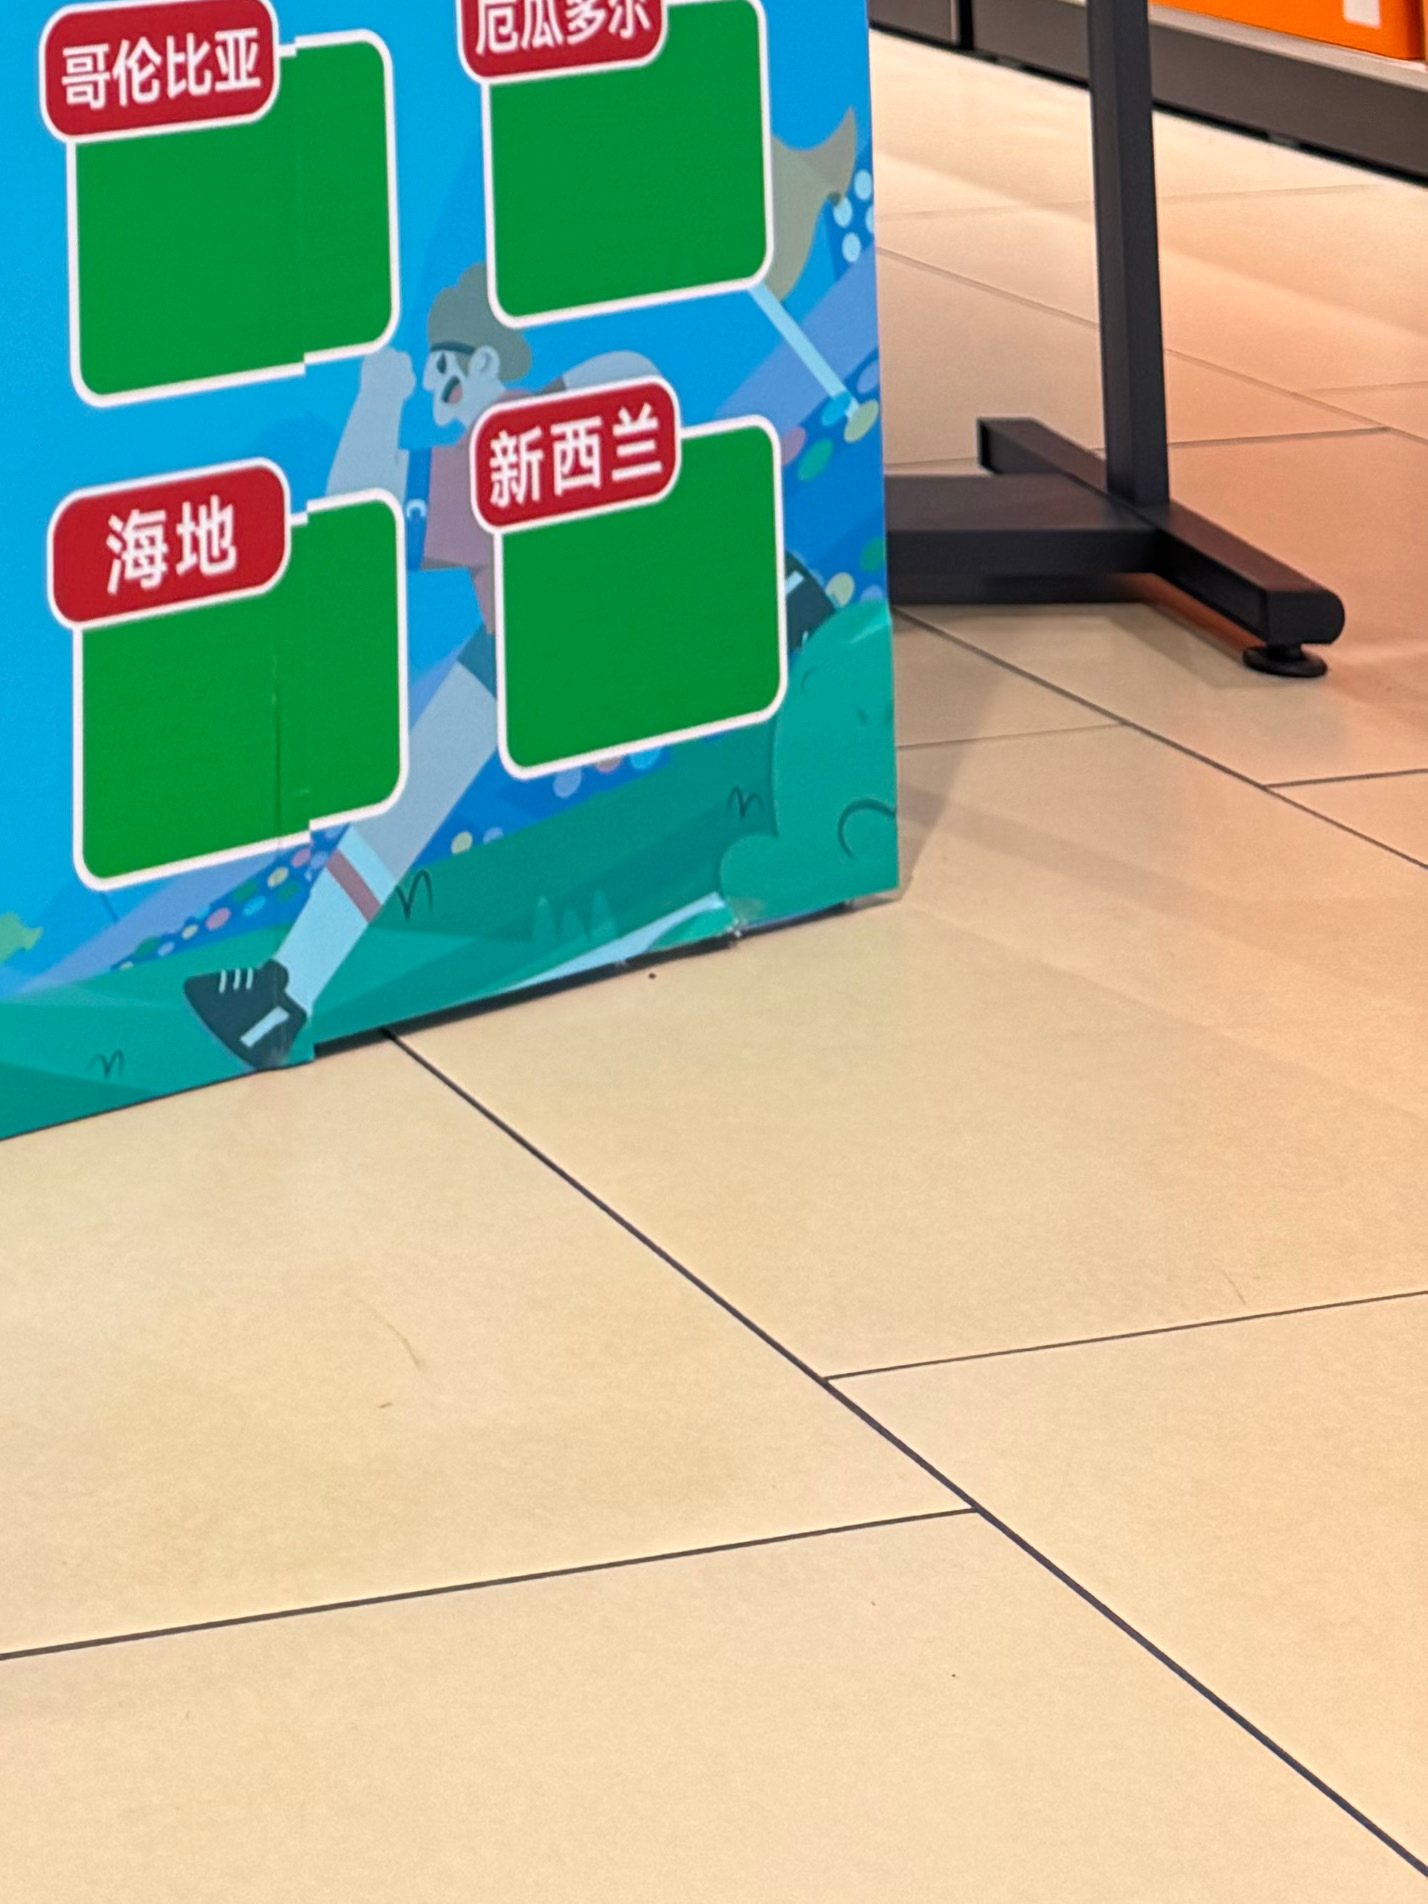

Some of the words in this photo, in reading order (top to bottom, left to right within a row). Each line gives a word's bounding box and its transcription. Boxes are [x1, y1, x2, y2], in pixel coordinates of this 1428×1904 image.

[62, 28, 261, 109] 哥伦比亚
[490, 403, 662, 507] 新西兰
[107, 495, 236, 594] 海地
